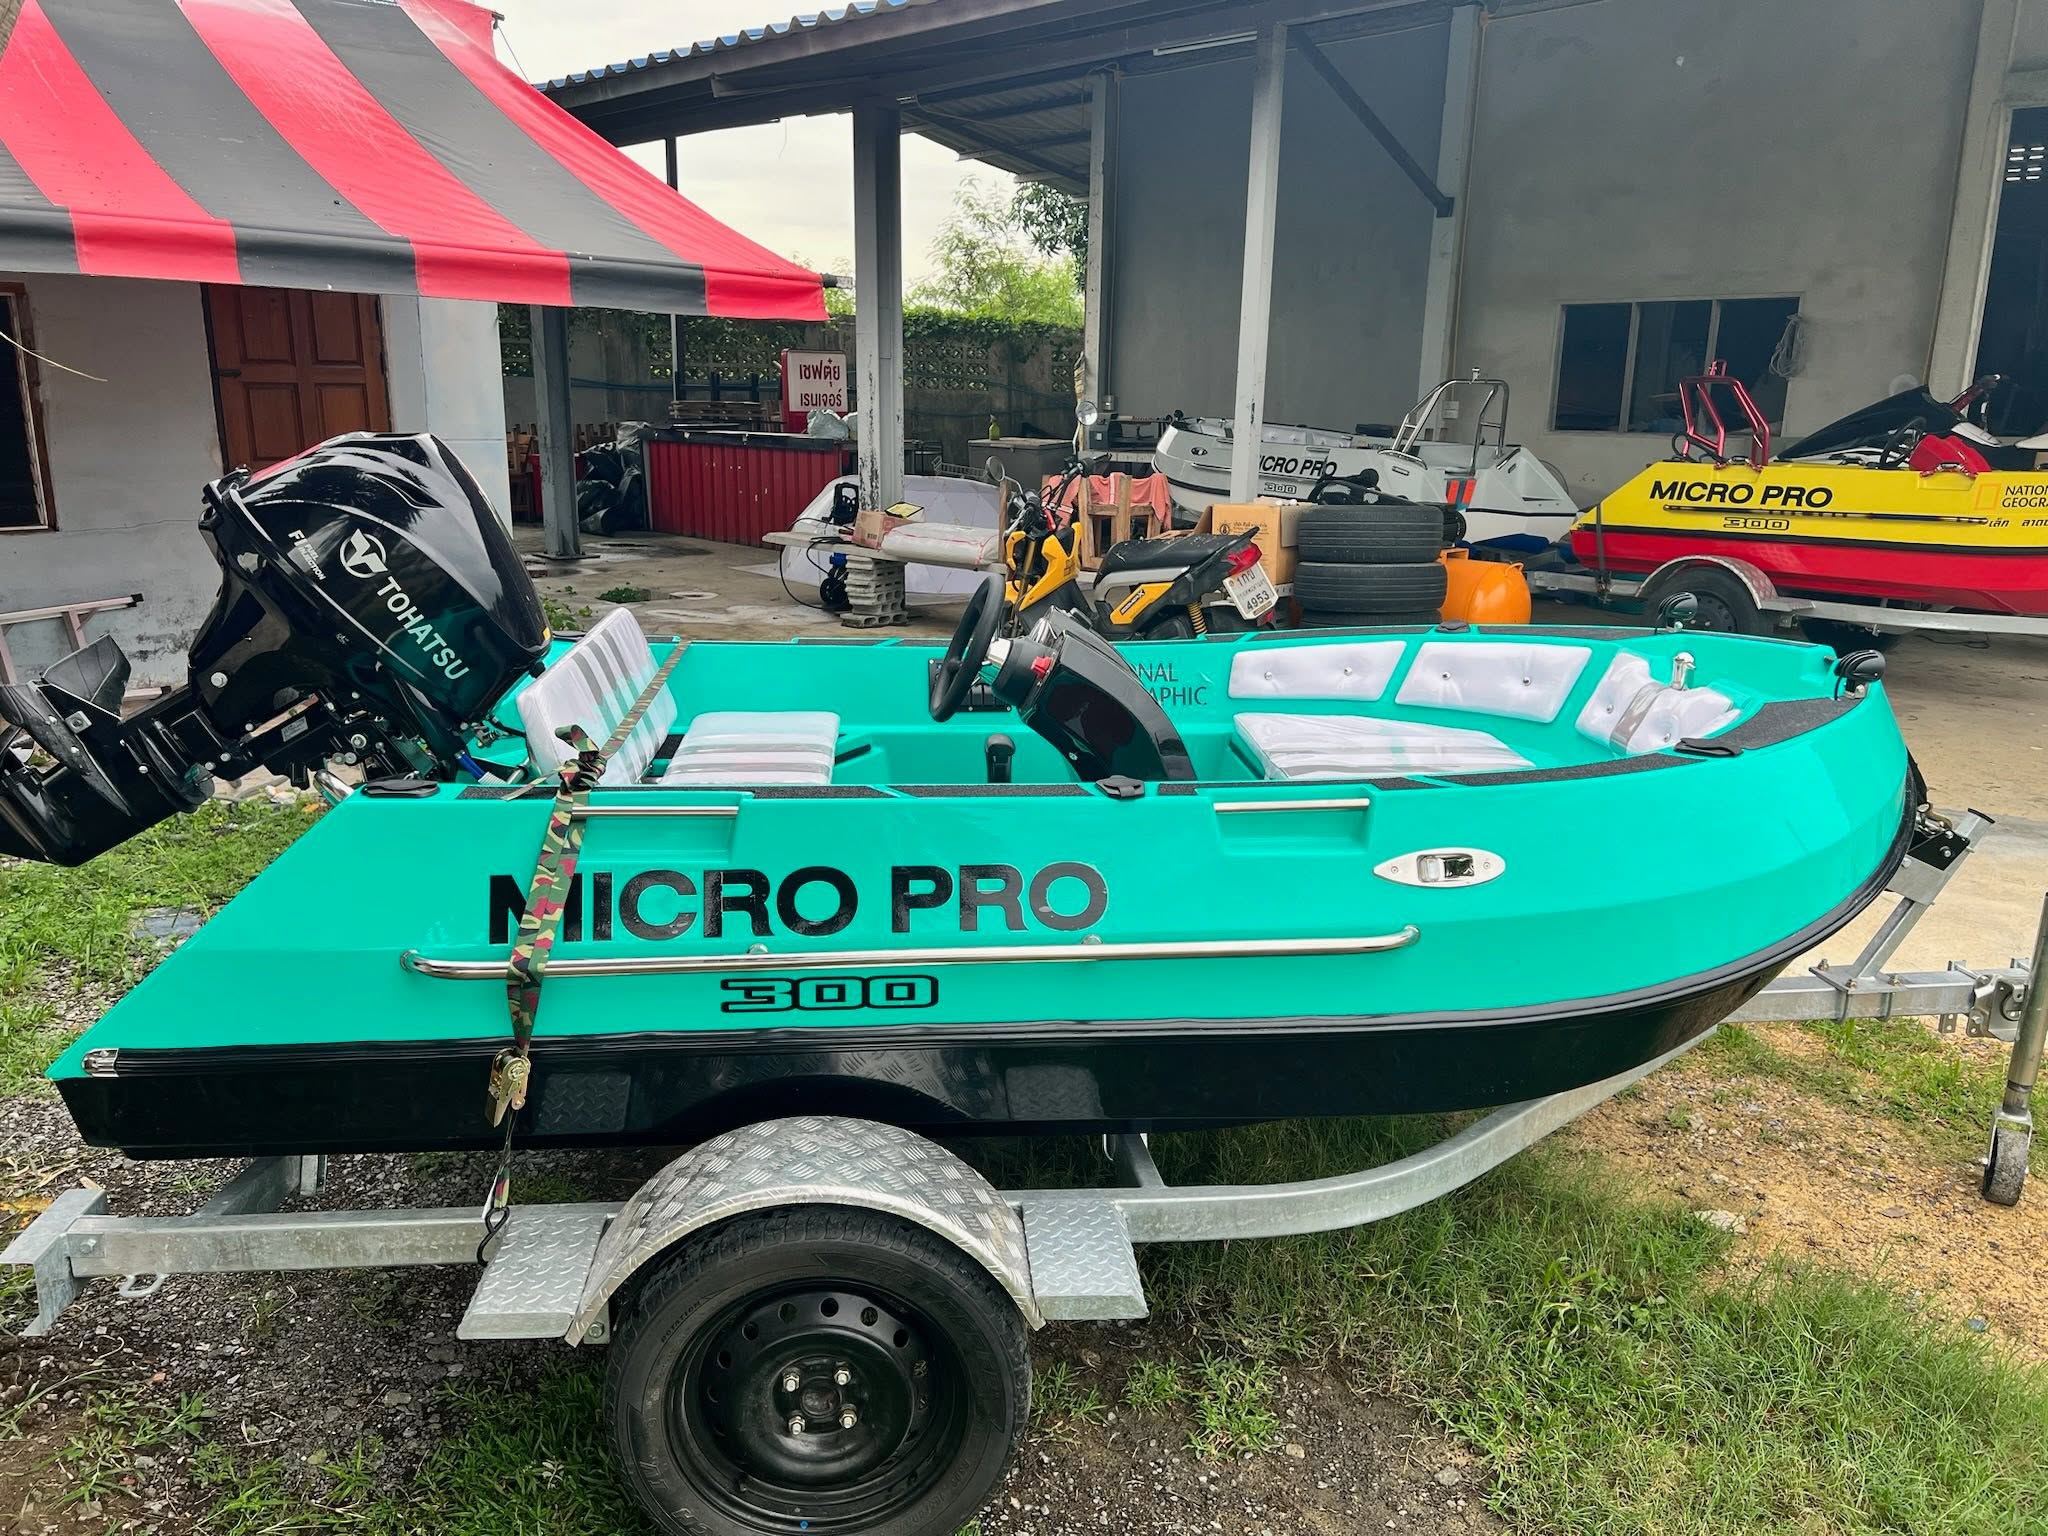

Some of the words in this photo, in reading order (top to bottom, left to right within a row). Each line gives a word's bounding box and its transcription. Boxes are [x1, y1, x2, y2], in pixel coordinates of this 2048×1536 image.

[1259, 455, 1299, 474] ICRO
[1300, 459, 1338, 477] PRO
[1264, 482, 1297, 495] 300
[1650, 481, 1753, 504] MICRO
[1760, 486, 1833, 508] PRO
[2002, 497, 2048, 508] GEOGR
[1723, 517, 1789, 531] 300
[288, 529, 308, 547] FI
[304, 543, 319, 562] FUEL
[298, 546, 327, 580] INJECTION
[1246, 590, 1270, 610] 4953
[376, 576, 469, 680] TOHATSU
[1131, 662, 1179, 682] NAL
[488, 865, 858, 945] MICRO
[891, 861, 1109, 934] PRO
[720, 974, 939, 1014] 300
